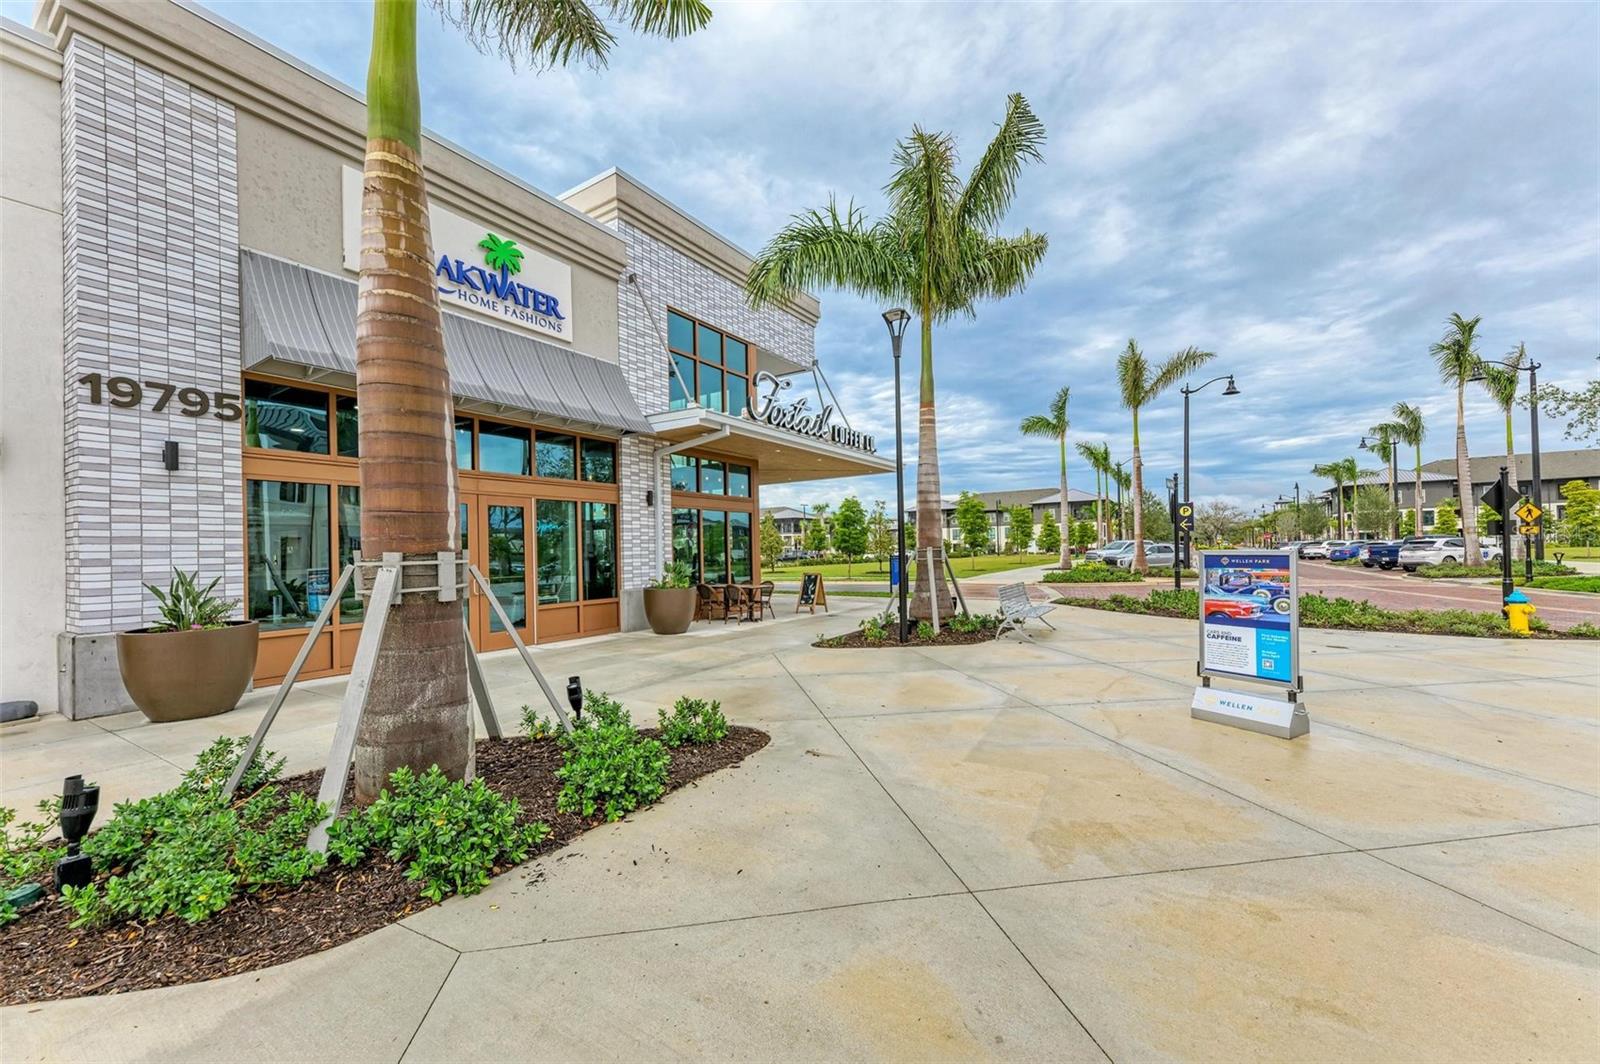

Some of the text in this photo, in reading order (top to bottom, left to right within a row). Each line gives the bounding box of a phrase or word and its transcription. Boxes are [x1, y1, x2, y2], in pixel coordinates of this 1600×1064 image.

[436, 255, 565, 320] AKWATER
[458, 289, 563, 333] HOME FASHIONS
[78, 373, 243, 422] 19795
[746, 371, 833, 439] Foxtail
[1206, 633, 1242, 642] CAFFEINE
[1219, 699, 1254, 711] WELLEN
